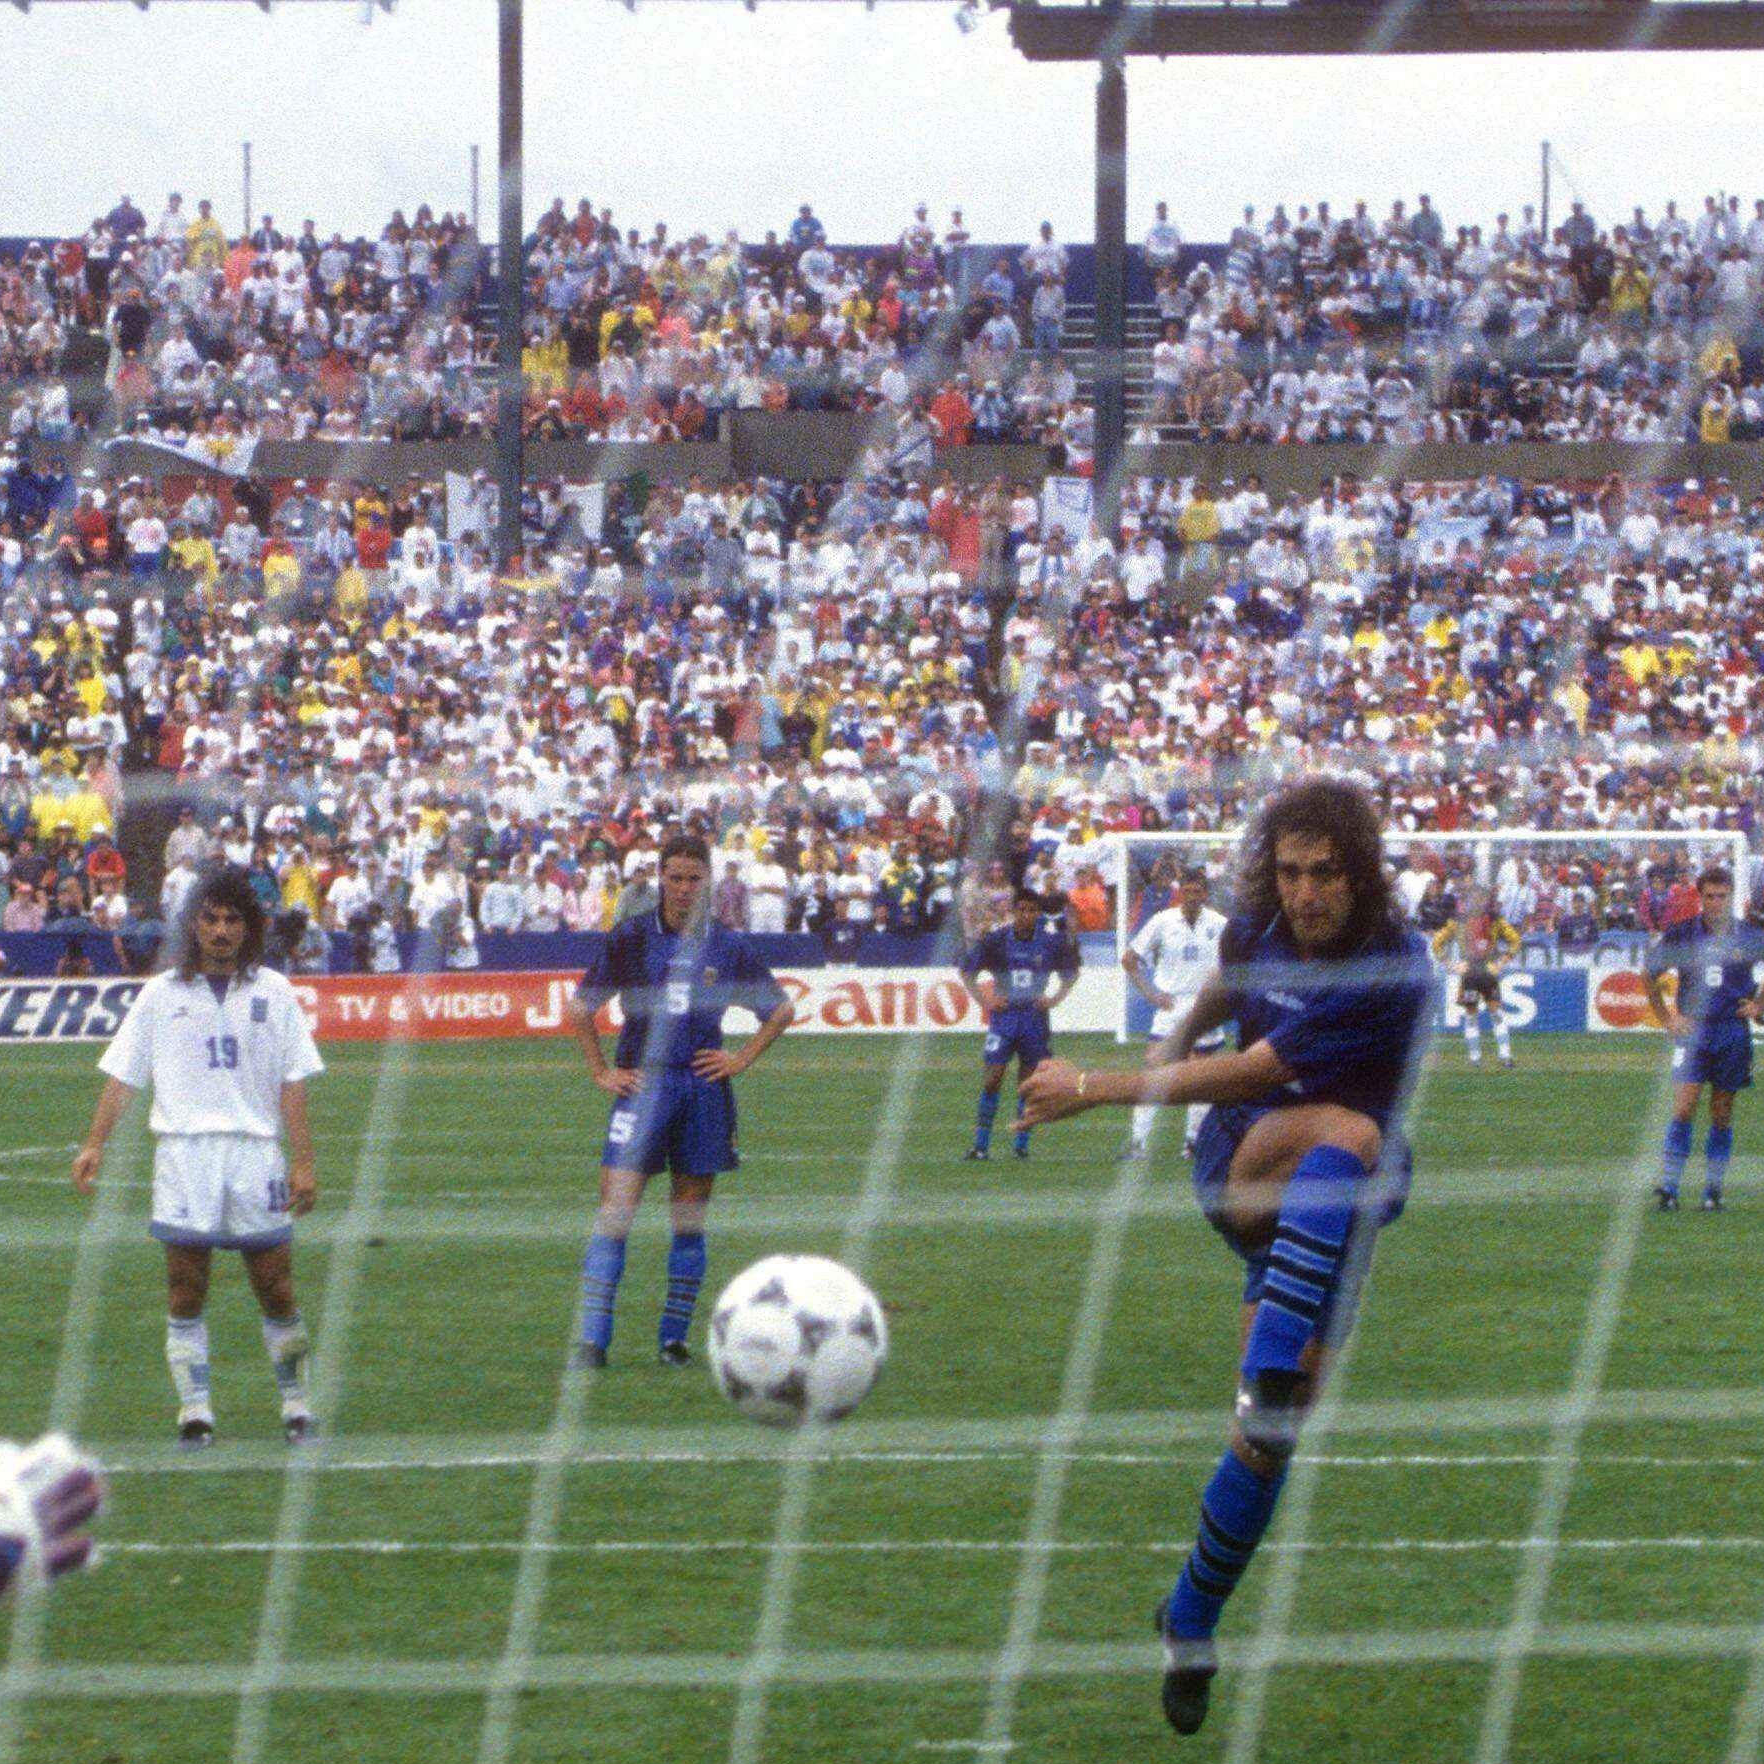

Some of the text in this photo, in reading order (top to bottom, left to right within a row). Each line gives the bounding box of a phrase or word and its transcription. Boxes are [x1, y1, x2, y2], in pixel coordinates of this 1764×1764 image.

[1011, 969, 1034, 989] 13
[337, 995, 376, 1021] TV
[423, 992, 511, 1020] VIDEO
[668, 983, 690, 1014] 5
[205, 1035, 240, 1070] 19
[608, 1110, 637, 1144] 5
